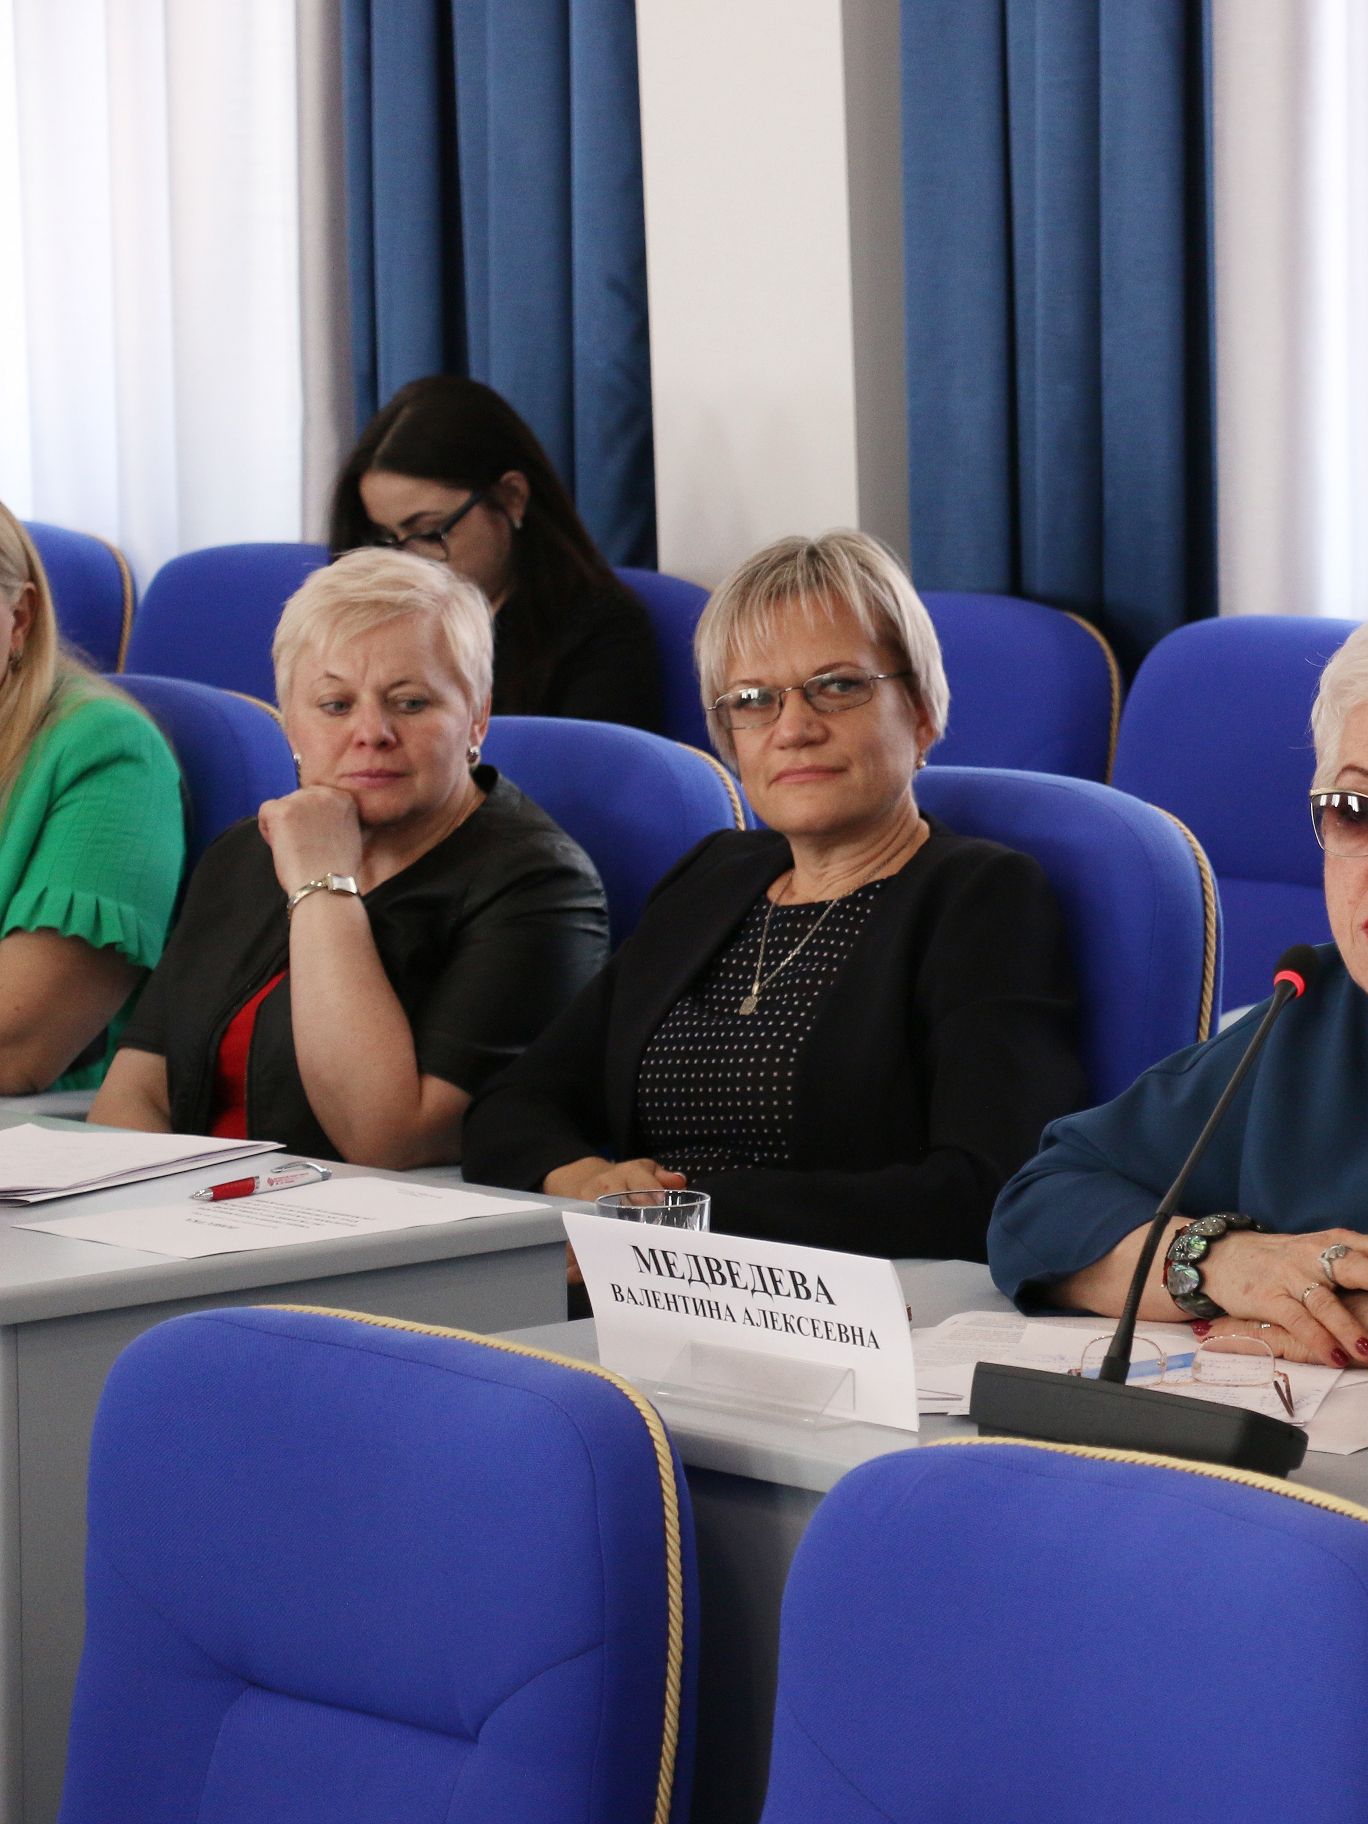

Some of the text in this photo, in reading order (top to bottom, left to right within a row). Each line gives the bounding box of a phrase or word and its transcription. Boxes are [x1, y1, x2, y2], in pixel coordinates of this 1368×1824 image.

[630, 1245, 837, 1306] МЕДВЕДЕВА
[610, 1283, 737, 1323] ВАЛЕНТИНА
[742, 1307, 881, 1350] АЛЕКСЕЕВНА
